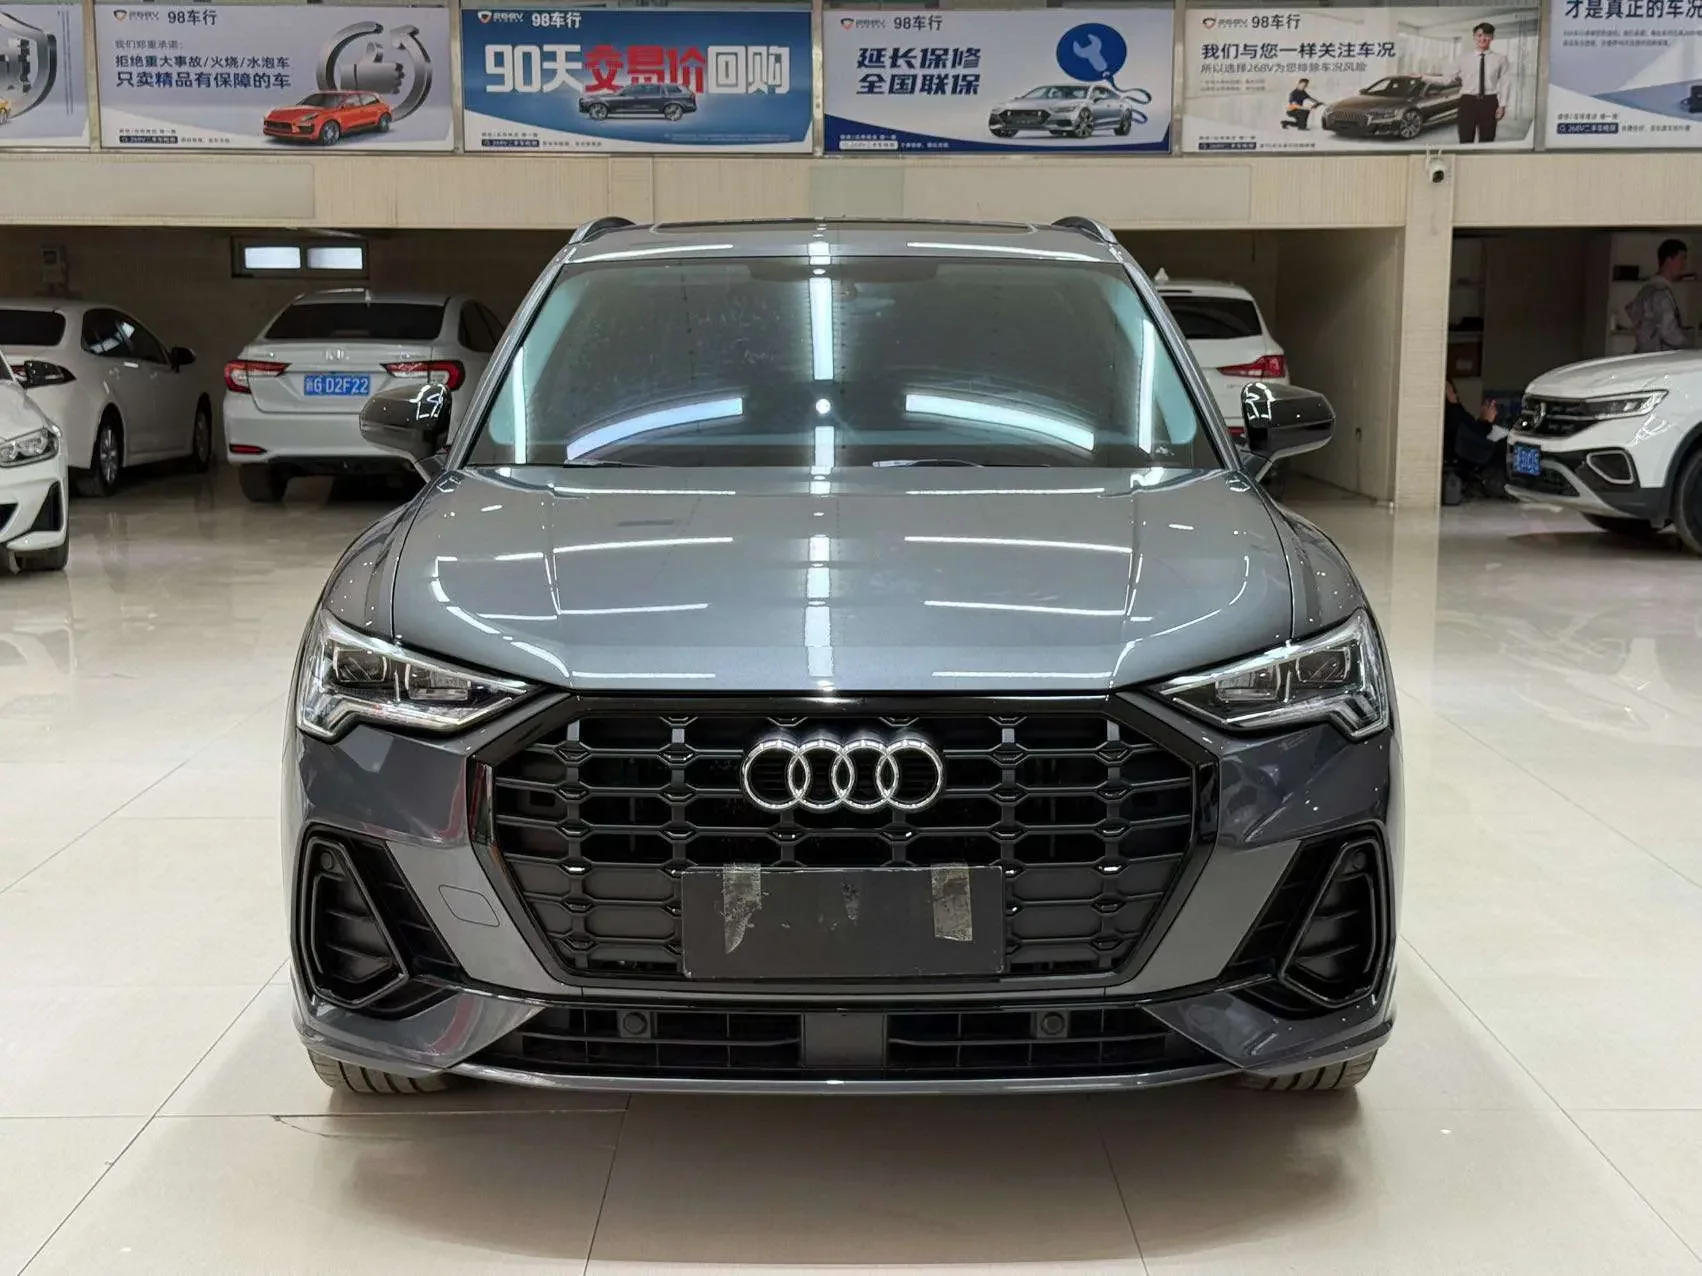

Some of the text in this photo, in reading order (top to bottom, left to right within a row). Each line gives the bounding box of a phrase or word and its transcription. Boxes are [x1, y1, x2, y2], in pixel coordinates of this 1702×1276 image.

[167, 9, 218, 26] 98车行
[531, 11, 581, 29] 98车行
[893, 15, 943, 32] 98车行
[1251, 14, 1300, 30] 98车行
[856, 47, 981, 69] 延长保修
[1201, 42, 1396, 59] 我们与您一样关注车况
[484, 44, 790, 94] 90天交易价回购
[116, 71, 291, 89] 只卖精品有保障的车
[856, 73, 981, 96] 全国联保
